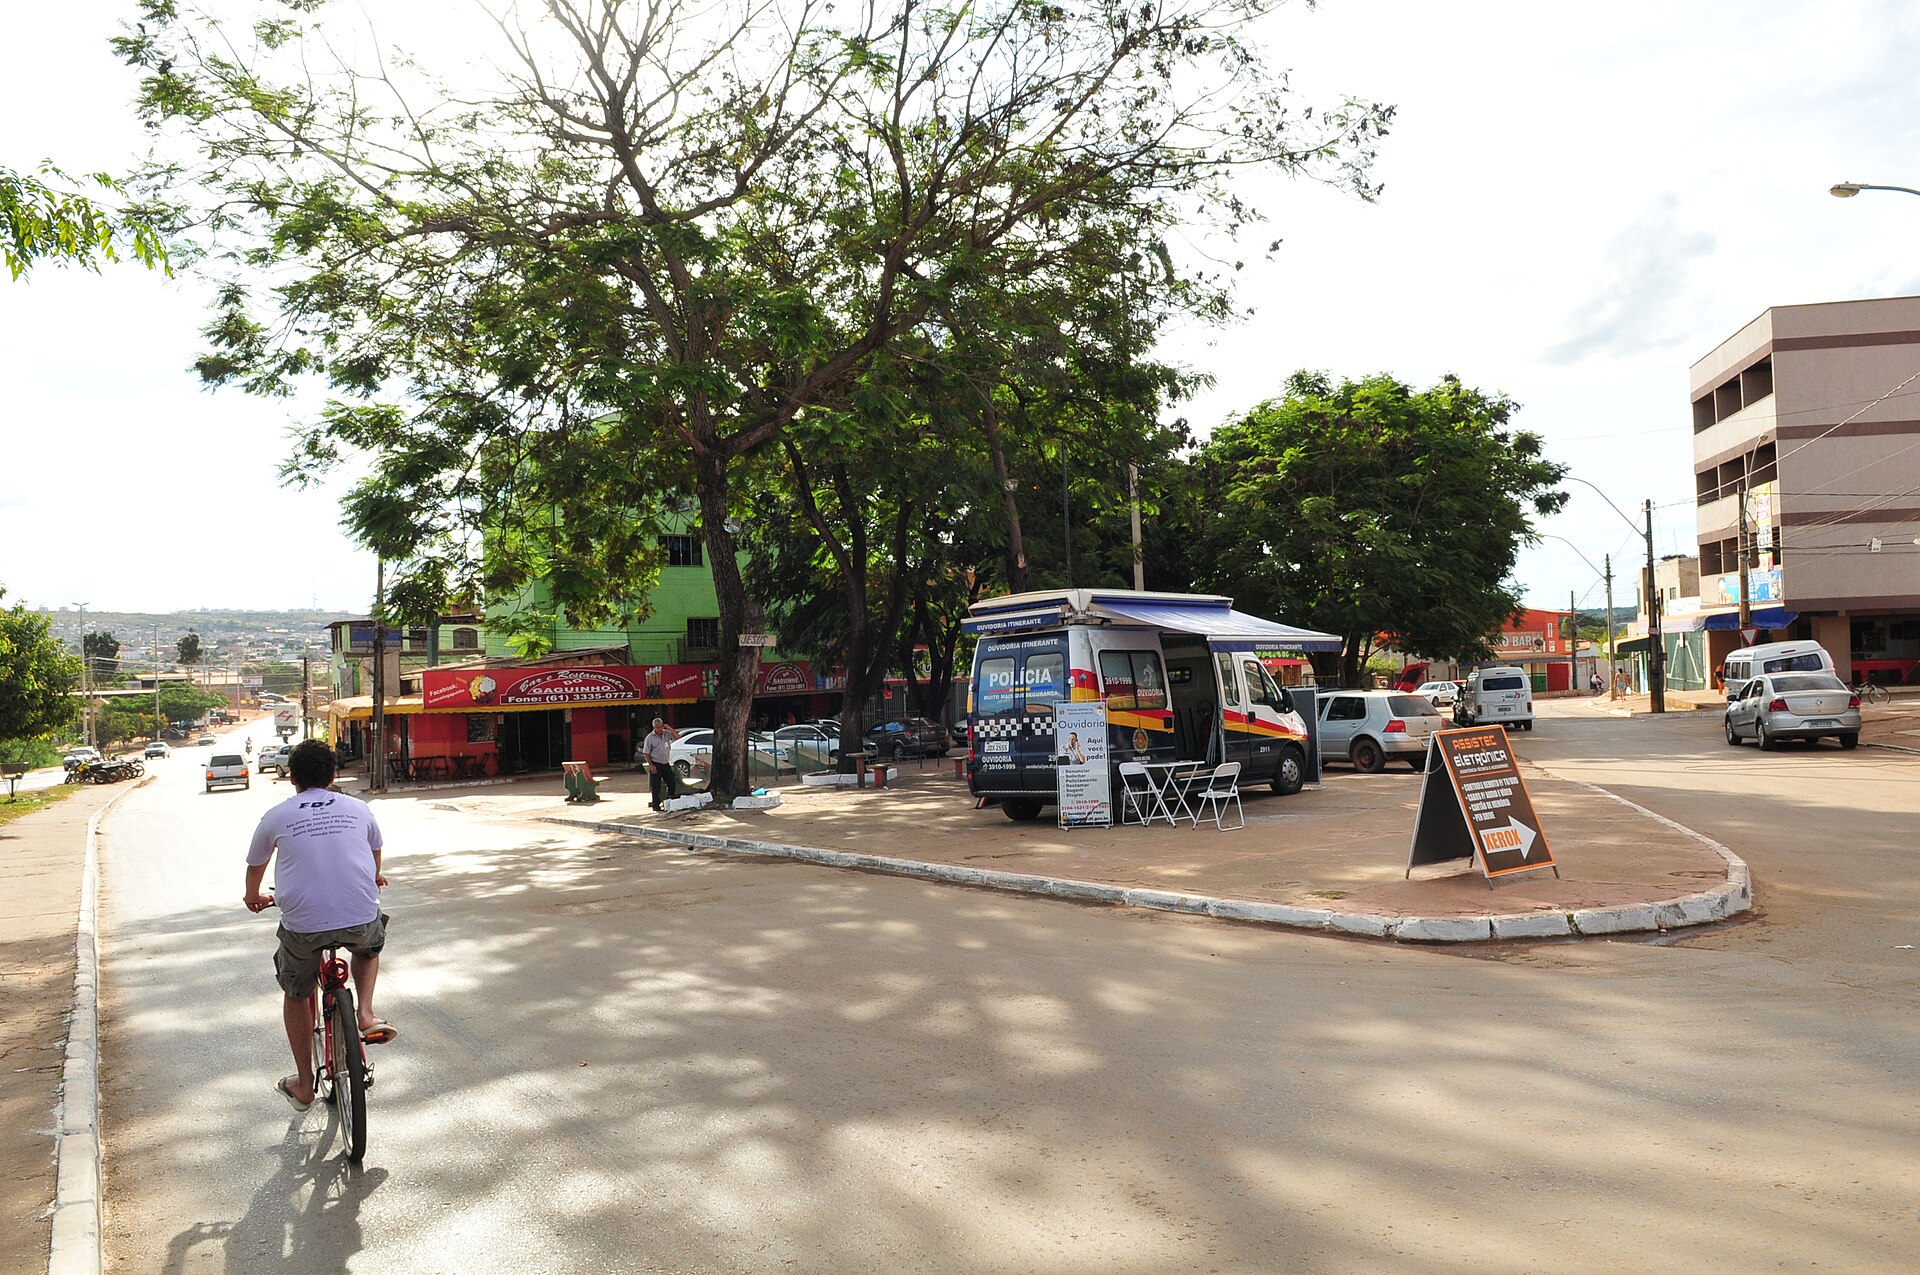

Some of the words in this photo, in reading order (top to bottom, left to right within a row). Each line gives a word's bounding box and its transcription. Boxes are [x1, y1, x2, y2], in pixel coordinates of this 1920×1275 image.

[1008, 618, 1041, 628] ITINERANTE
[740, 635, 768, 645] JESUS
[988, 642, 1020, 652] OUVIDORIA
[1021, 639, 1058, 648] ITINERANTE
[1512, 636, 1532, 646] BAR
[520, 679, 542, 692] Bar
[557, 670, 625, 690] Restaurante
[989, 667, 1052, 687] POLÍCIA
[429, 683, 458, 696] Facebook:
[532, 686, 611, 694] GAGUINHO
[666, 682, 677, 690] Disk
[546, 694, 569, 703] (61)
[573, 692, 634, 700] 3335-0772
[1059, 719, 1104, 729] Ouvidoria
[1452, 735, 1497, 750] ASSISTEC
[299, 798, 336, 809] FDJ
[1474, 813, 1483, 821] PEN
[1483, 829, 1522, 850] XEROX
